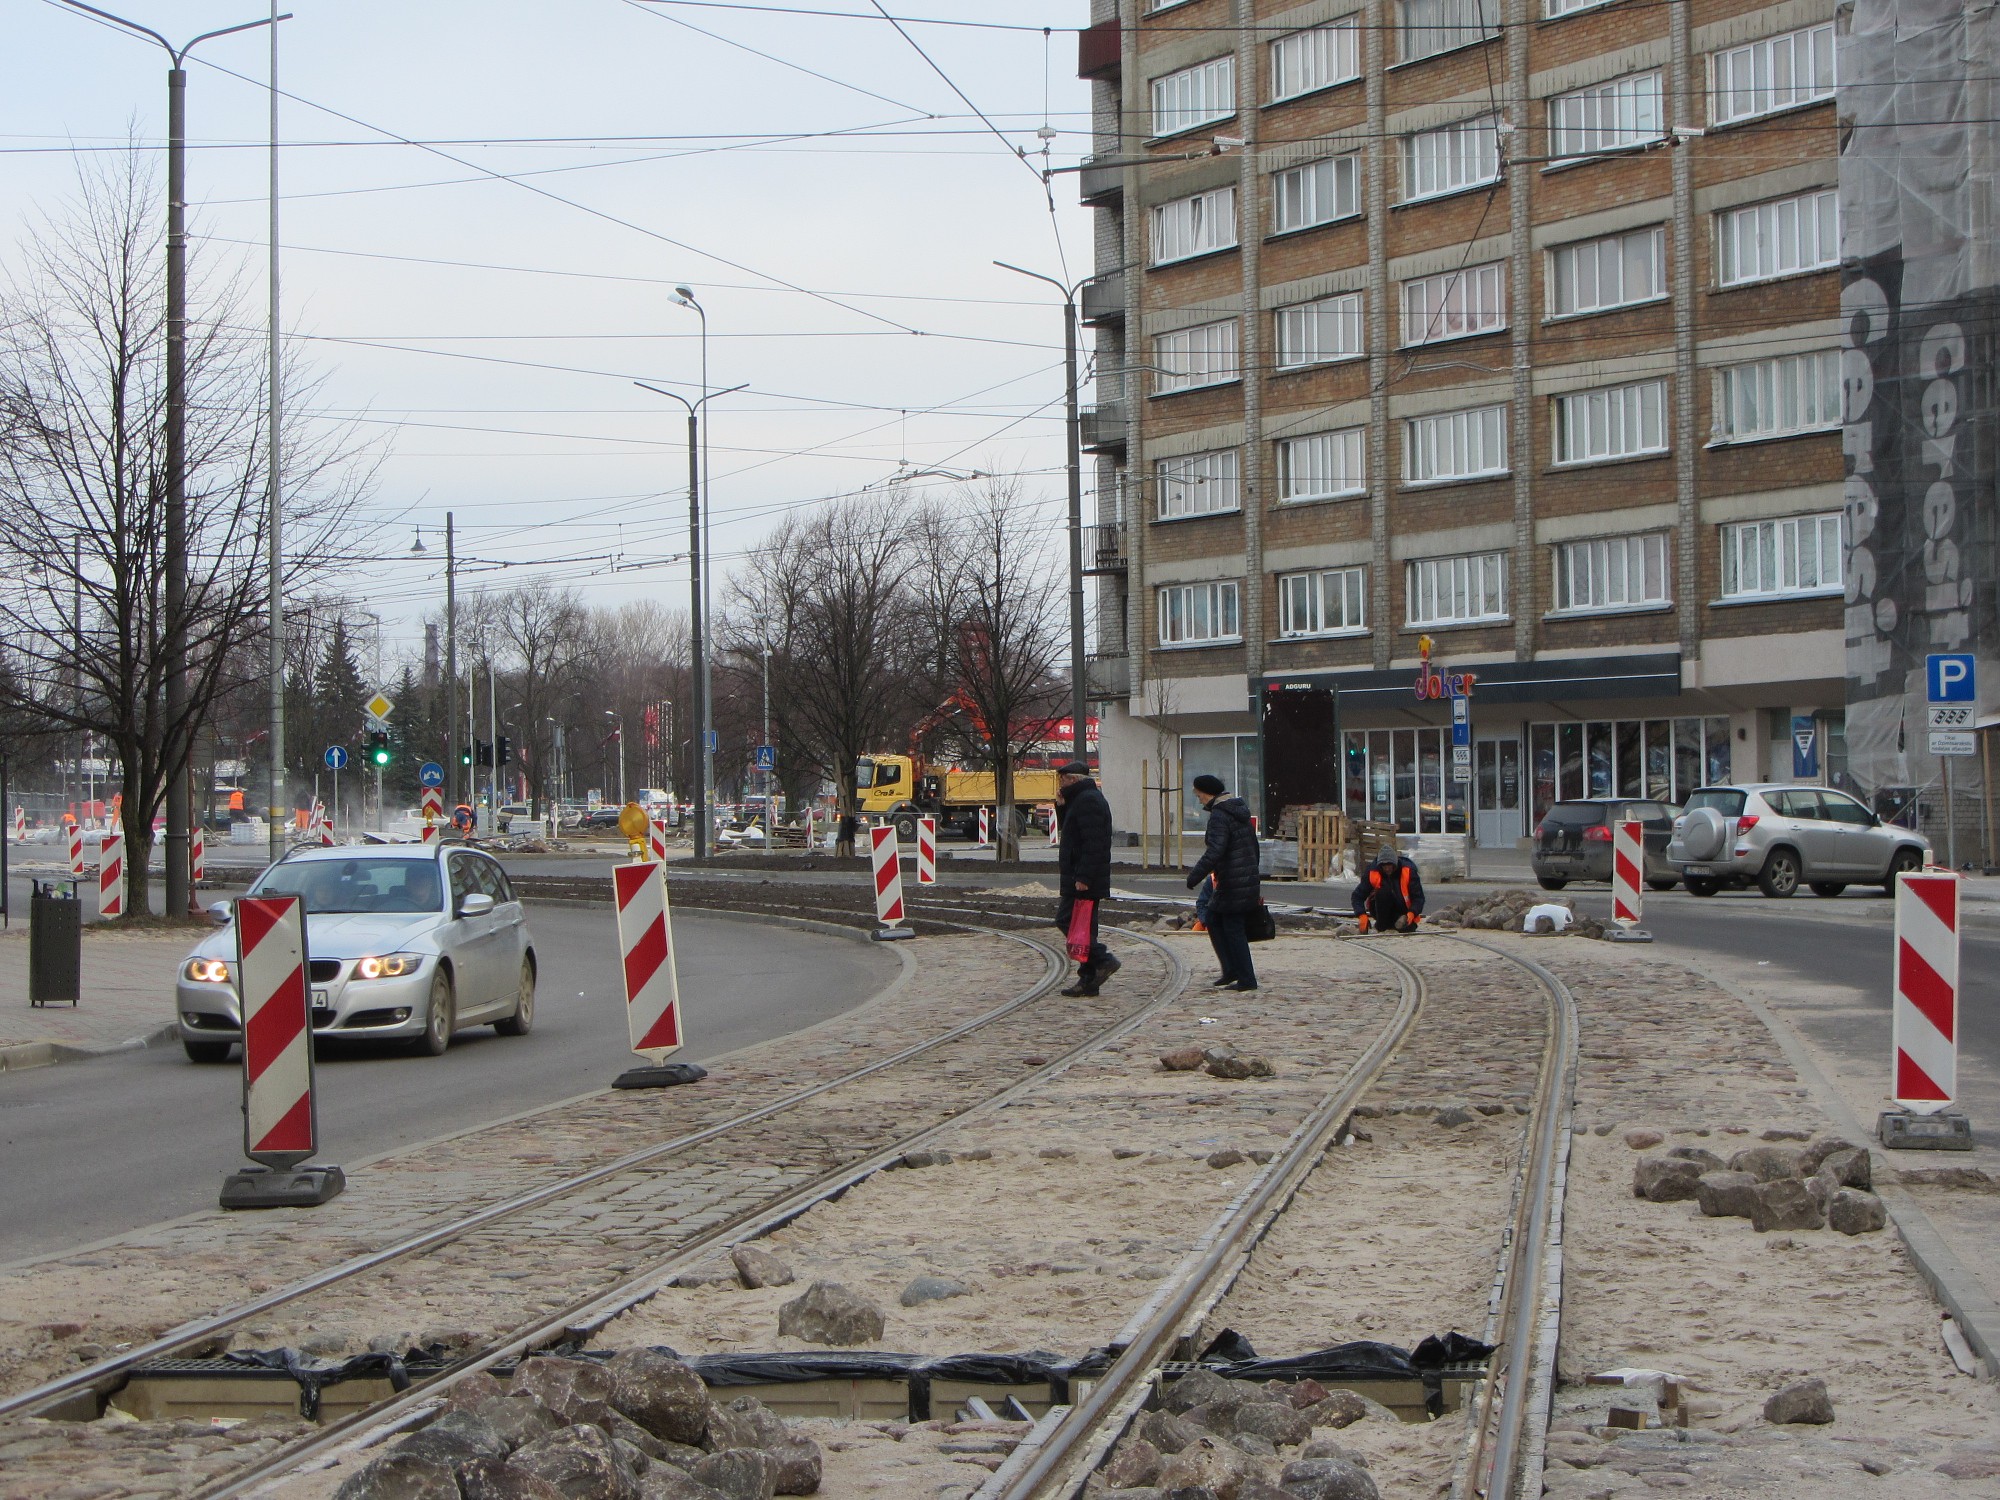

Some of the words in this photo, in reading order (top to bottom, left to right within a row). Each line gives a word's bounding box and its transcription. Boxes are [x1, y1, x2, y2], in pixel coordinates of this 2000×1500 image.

[1841, 278, 1898, 687] Ceresit
[1919, 322, 1973, 651] Ceresit
[1414, 661, 1476, 700] Joker
[1939, 659, 1967, 698] P
